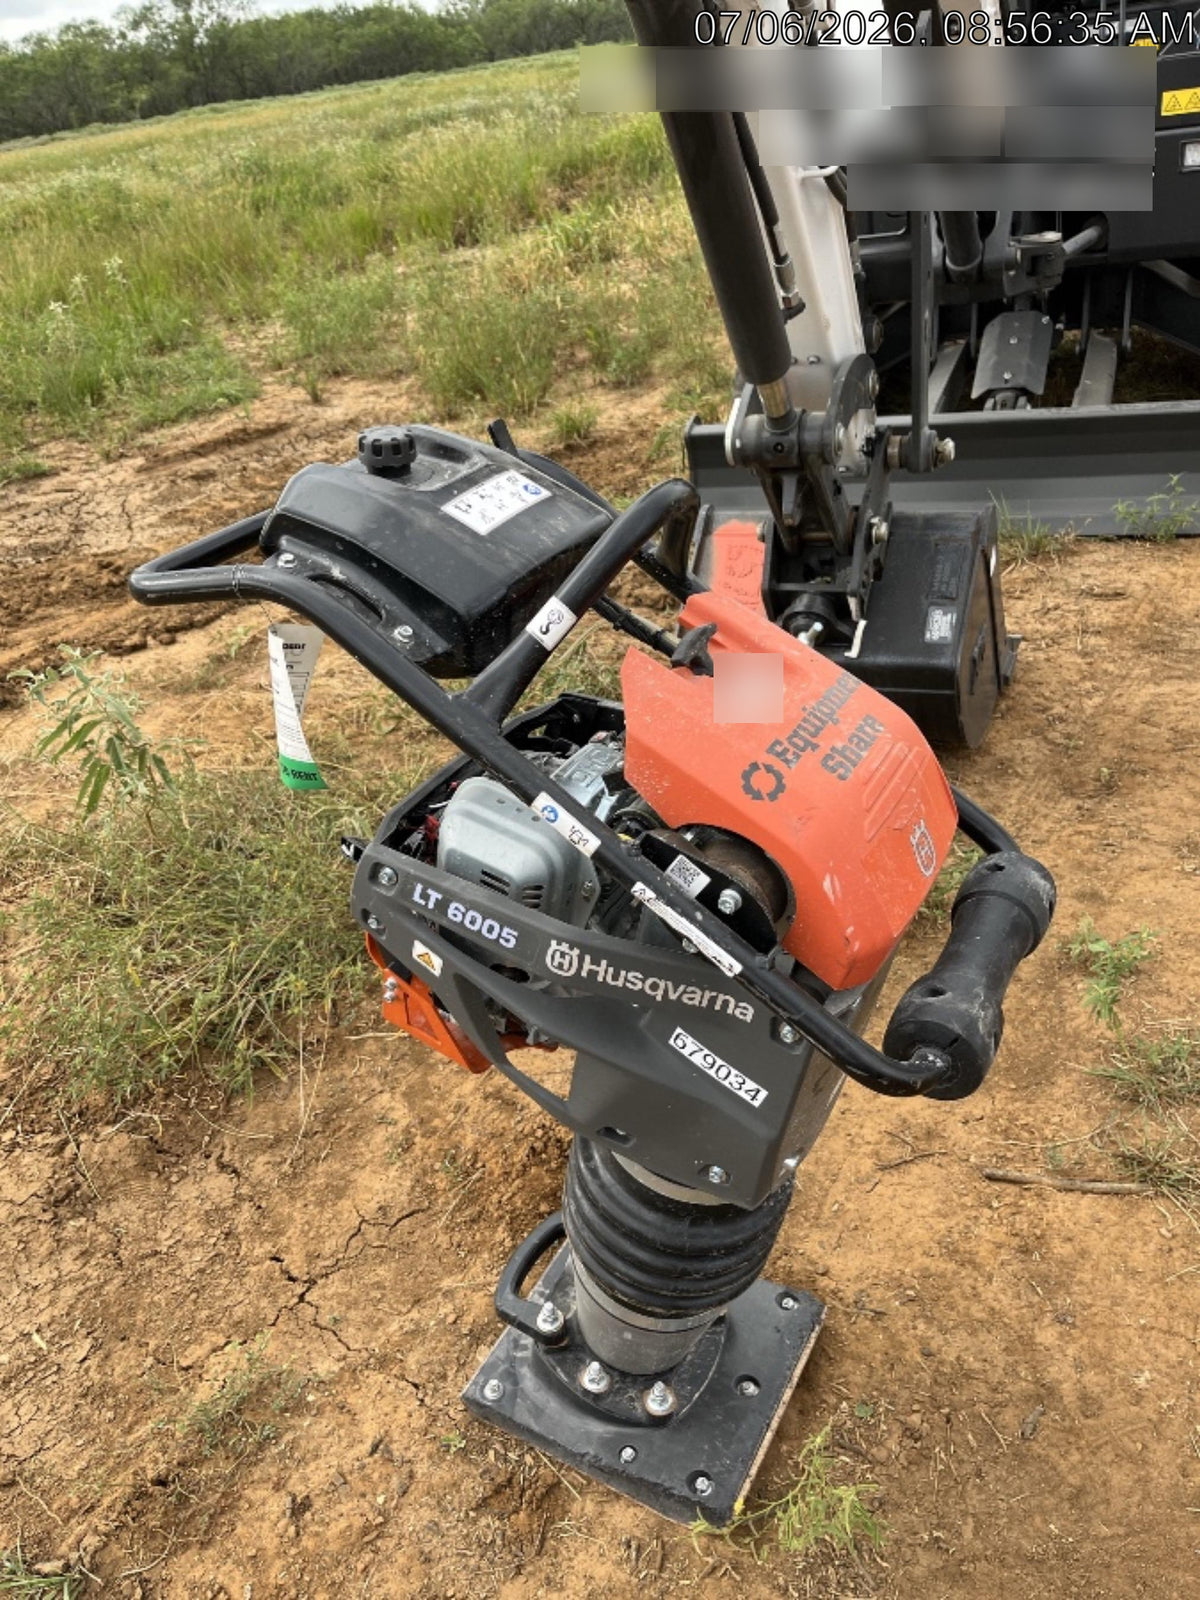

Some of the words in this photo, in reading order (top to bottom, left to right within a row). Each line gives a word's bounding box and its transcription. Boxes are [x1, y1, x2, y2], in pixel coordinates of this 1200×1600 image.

[822, 715, 885, 780] Share
[412, 883, 442, 910] LT
[447, 902, 519, 949] 6005
[580, 953, 755, 1022] Husqvarna
[673, 1032, 761, 1101] 679034
